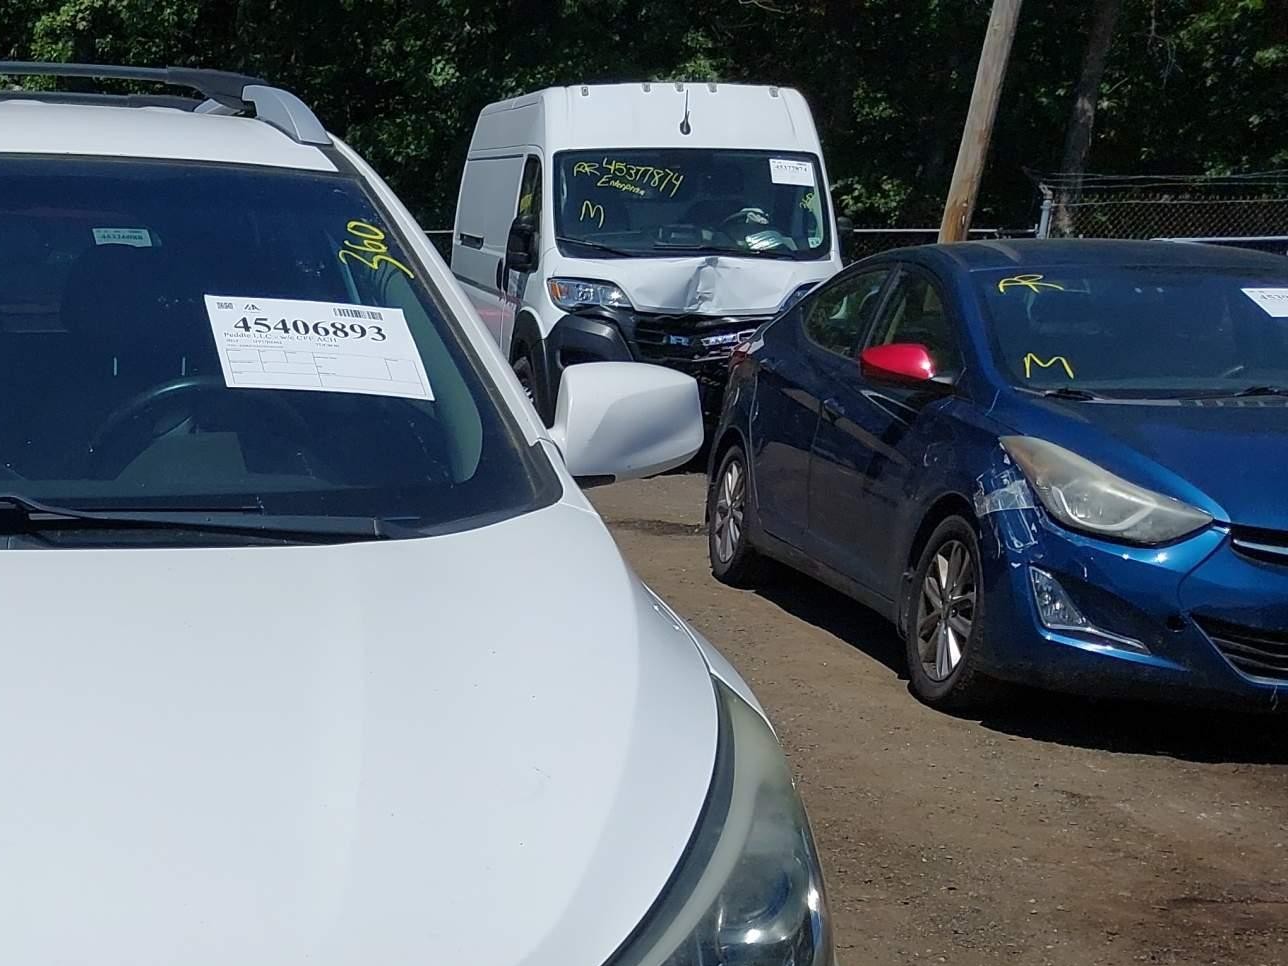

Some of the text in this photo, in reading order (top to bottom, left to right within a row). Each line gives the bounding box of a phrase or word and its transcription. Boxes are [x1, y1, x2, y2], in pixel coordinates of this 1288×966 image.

[602, 157, 684, 197] 45377874
[579, 200, 605, 228] M
[233, 316, 387, 342] 45406893
[1024, 352, 1074, 378] M
